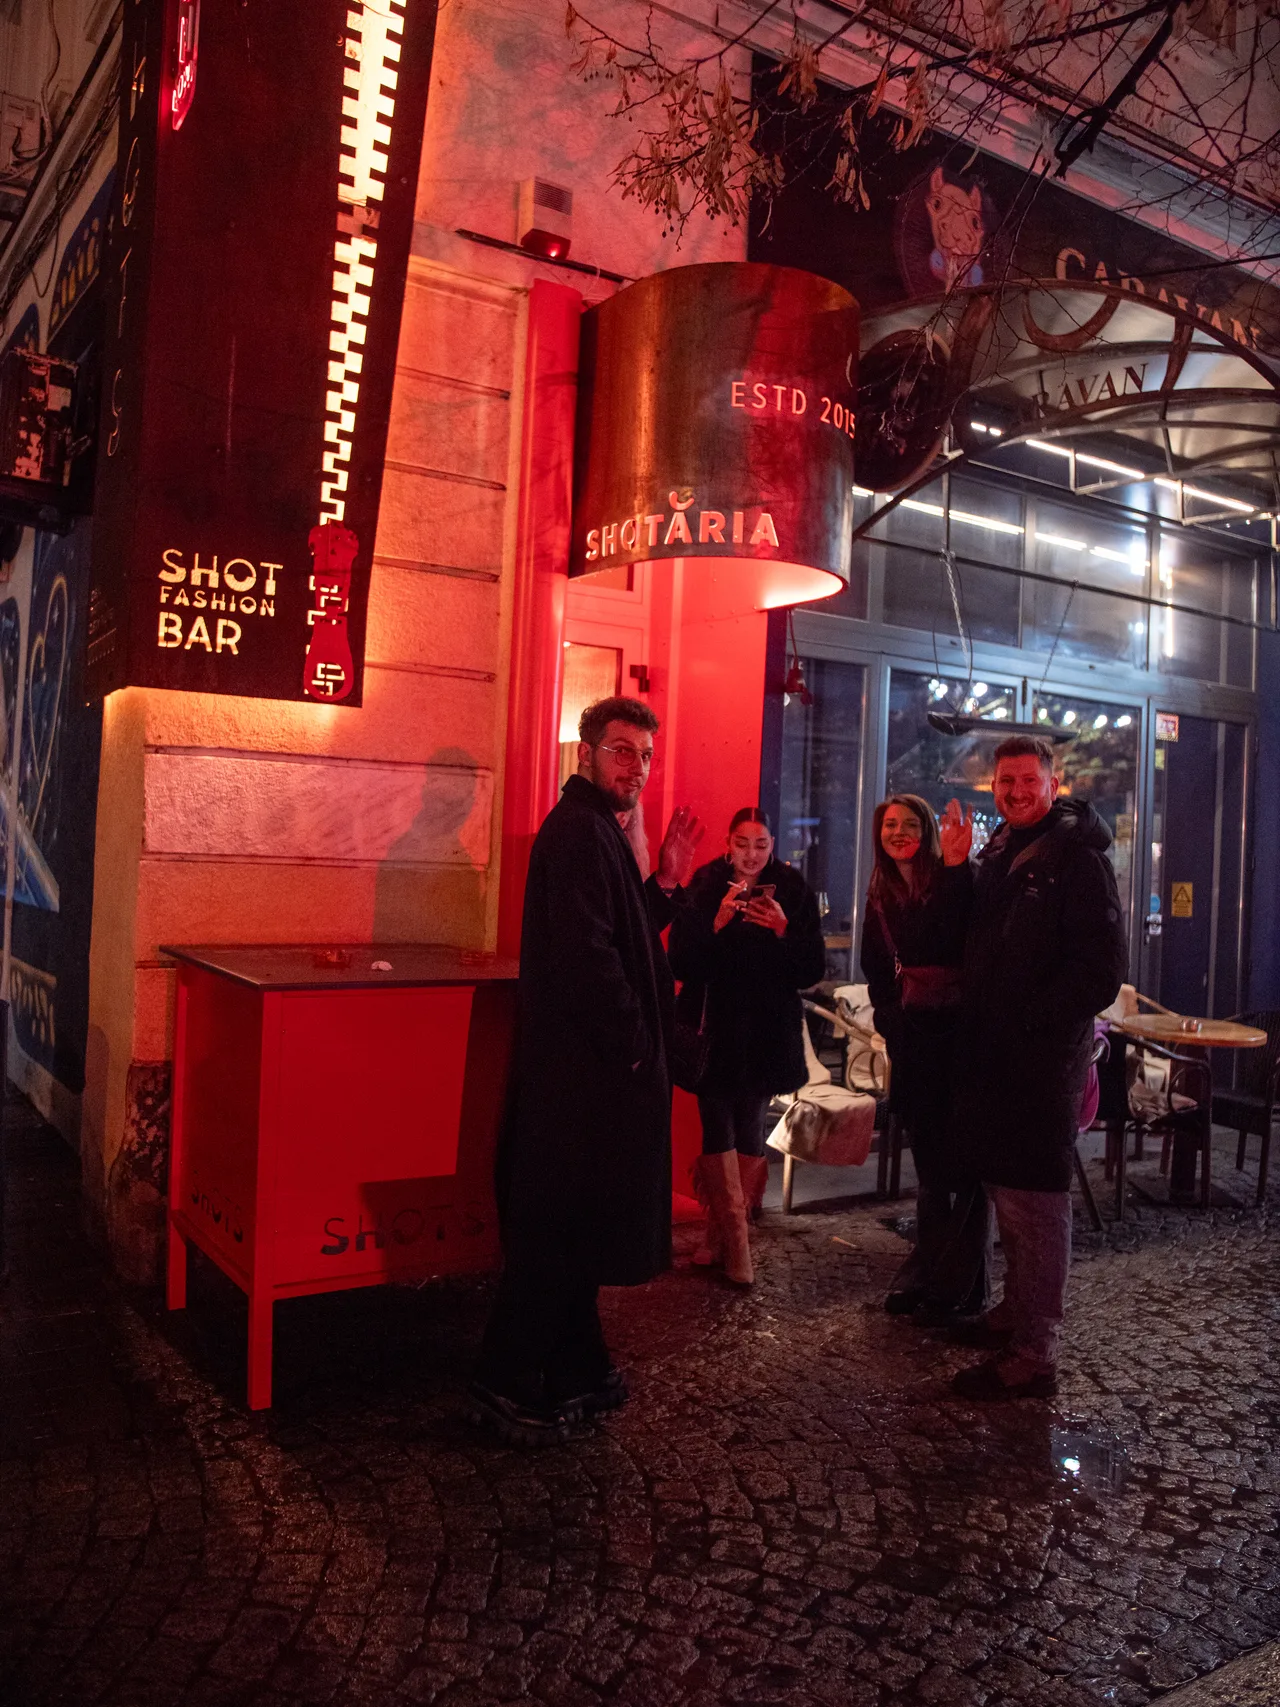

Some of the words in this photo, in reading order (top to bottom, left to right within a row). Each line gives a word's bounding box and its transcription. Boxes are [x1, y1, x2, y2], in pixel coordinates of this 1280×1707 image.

[731, 381, 808, 415] ESTD
[819, 397, 858, 439] 2015
[157, 548, 284, 596] SHOT
[159, 586, 276, 618] FASHION
[157, 611, 242, 656] BAR
